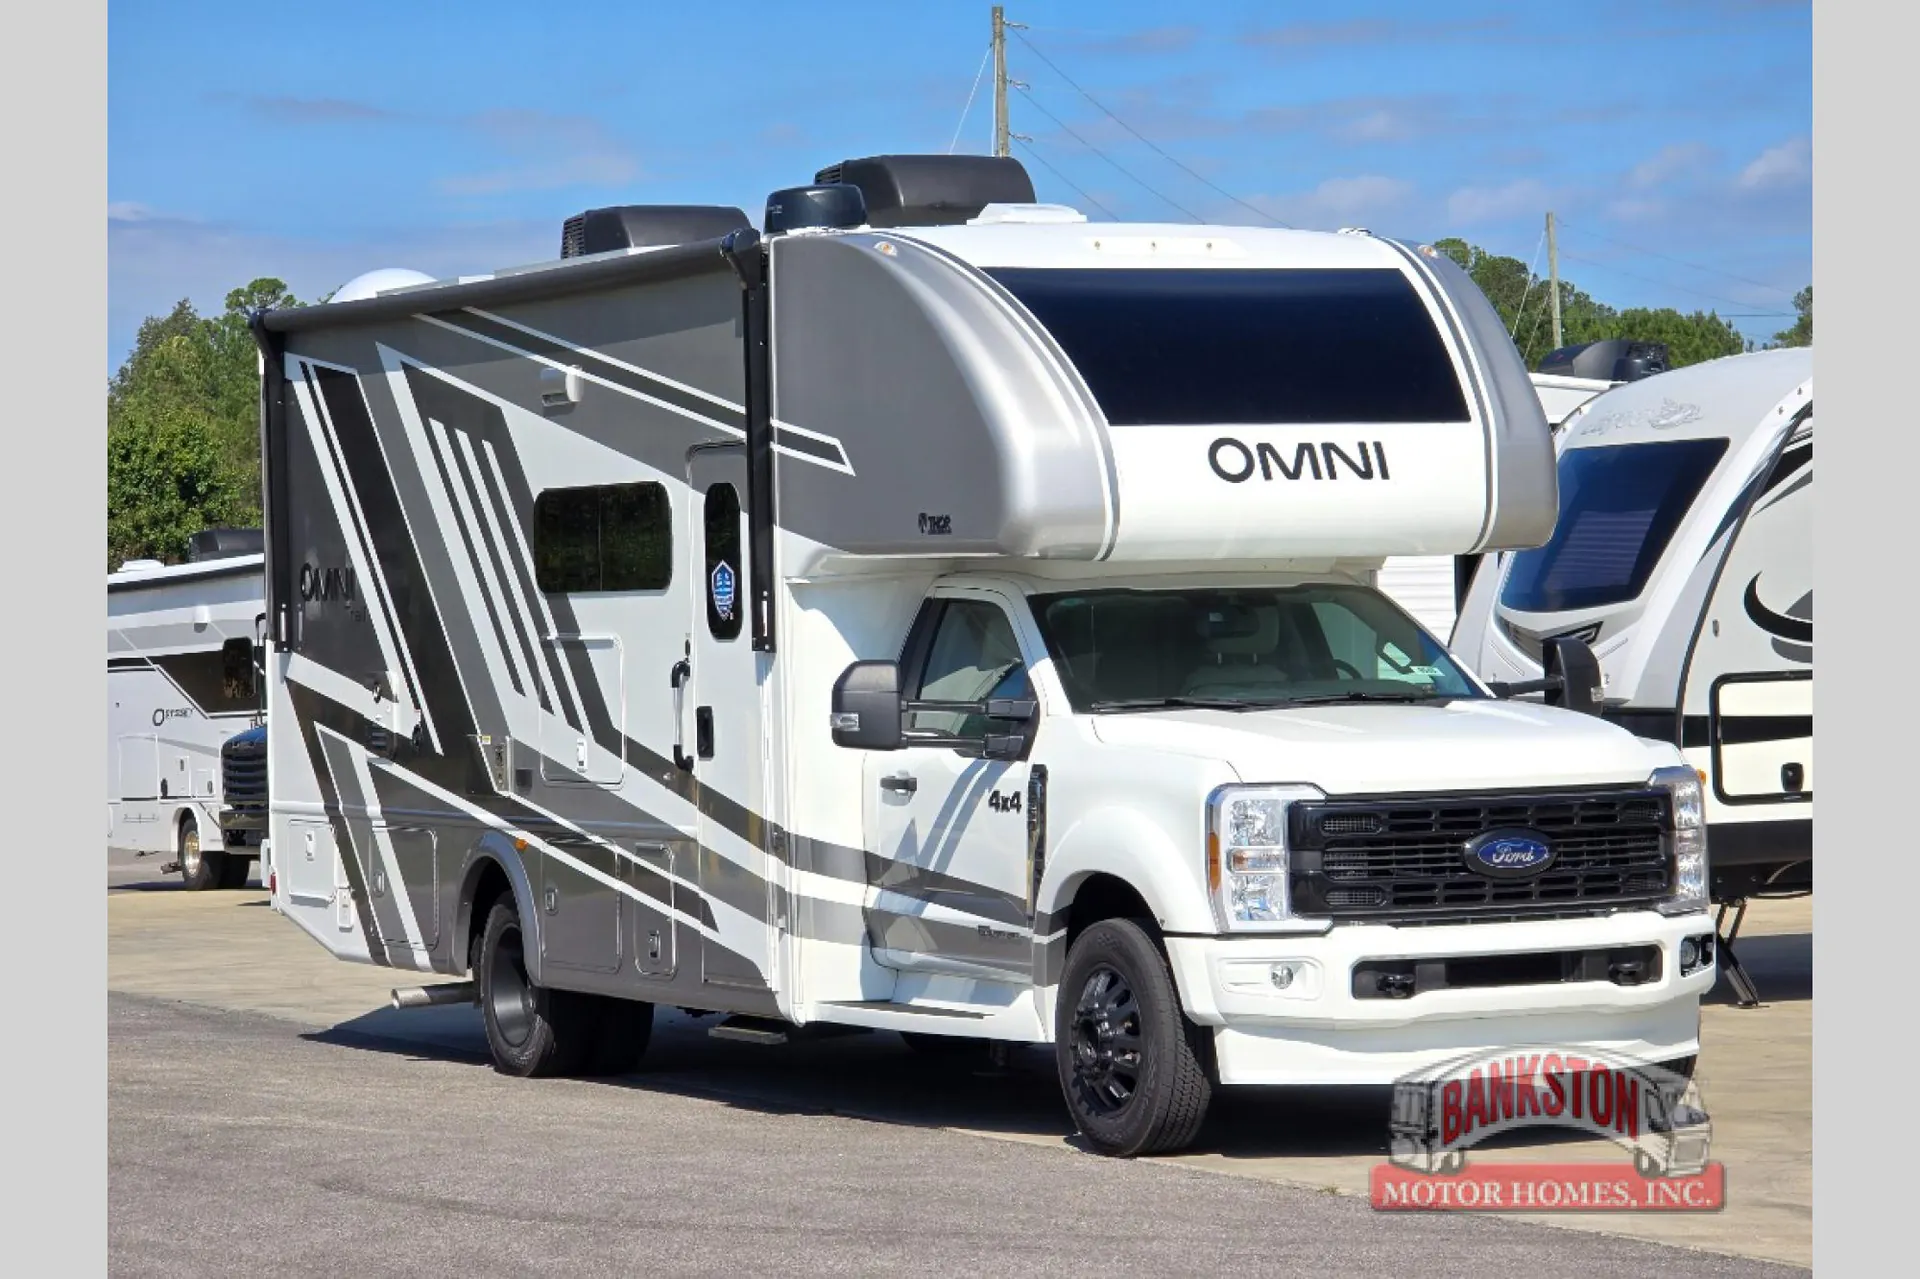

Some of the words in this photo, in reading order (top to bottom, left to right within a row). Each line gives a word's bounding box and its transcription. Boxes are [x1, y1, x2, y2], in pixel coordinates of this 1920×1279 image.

[1208, 437, 1390, 483] OMNI
[300, 562, 356, 602] OMNI
[988, 789, 1022, 814] 4x4
[1492, 841, 1535, 864] Ford
